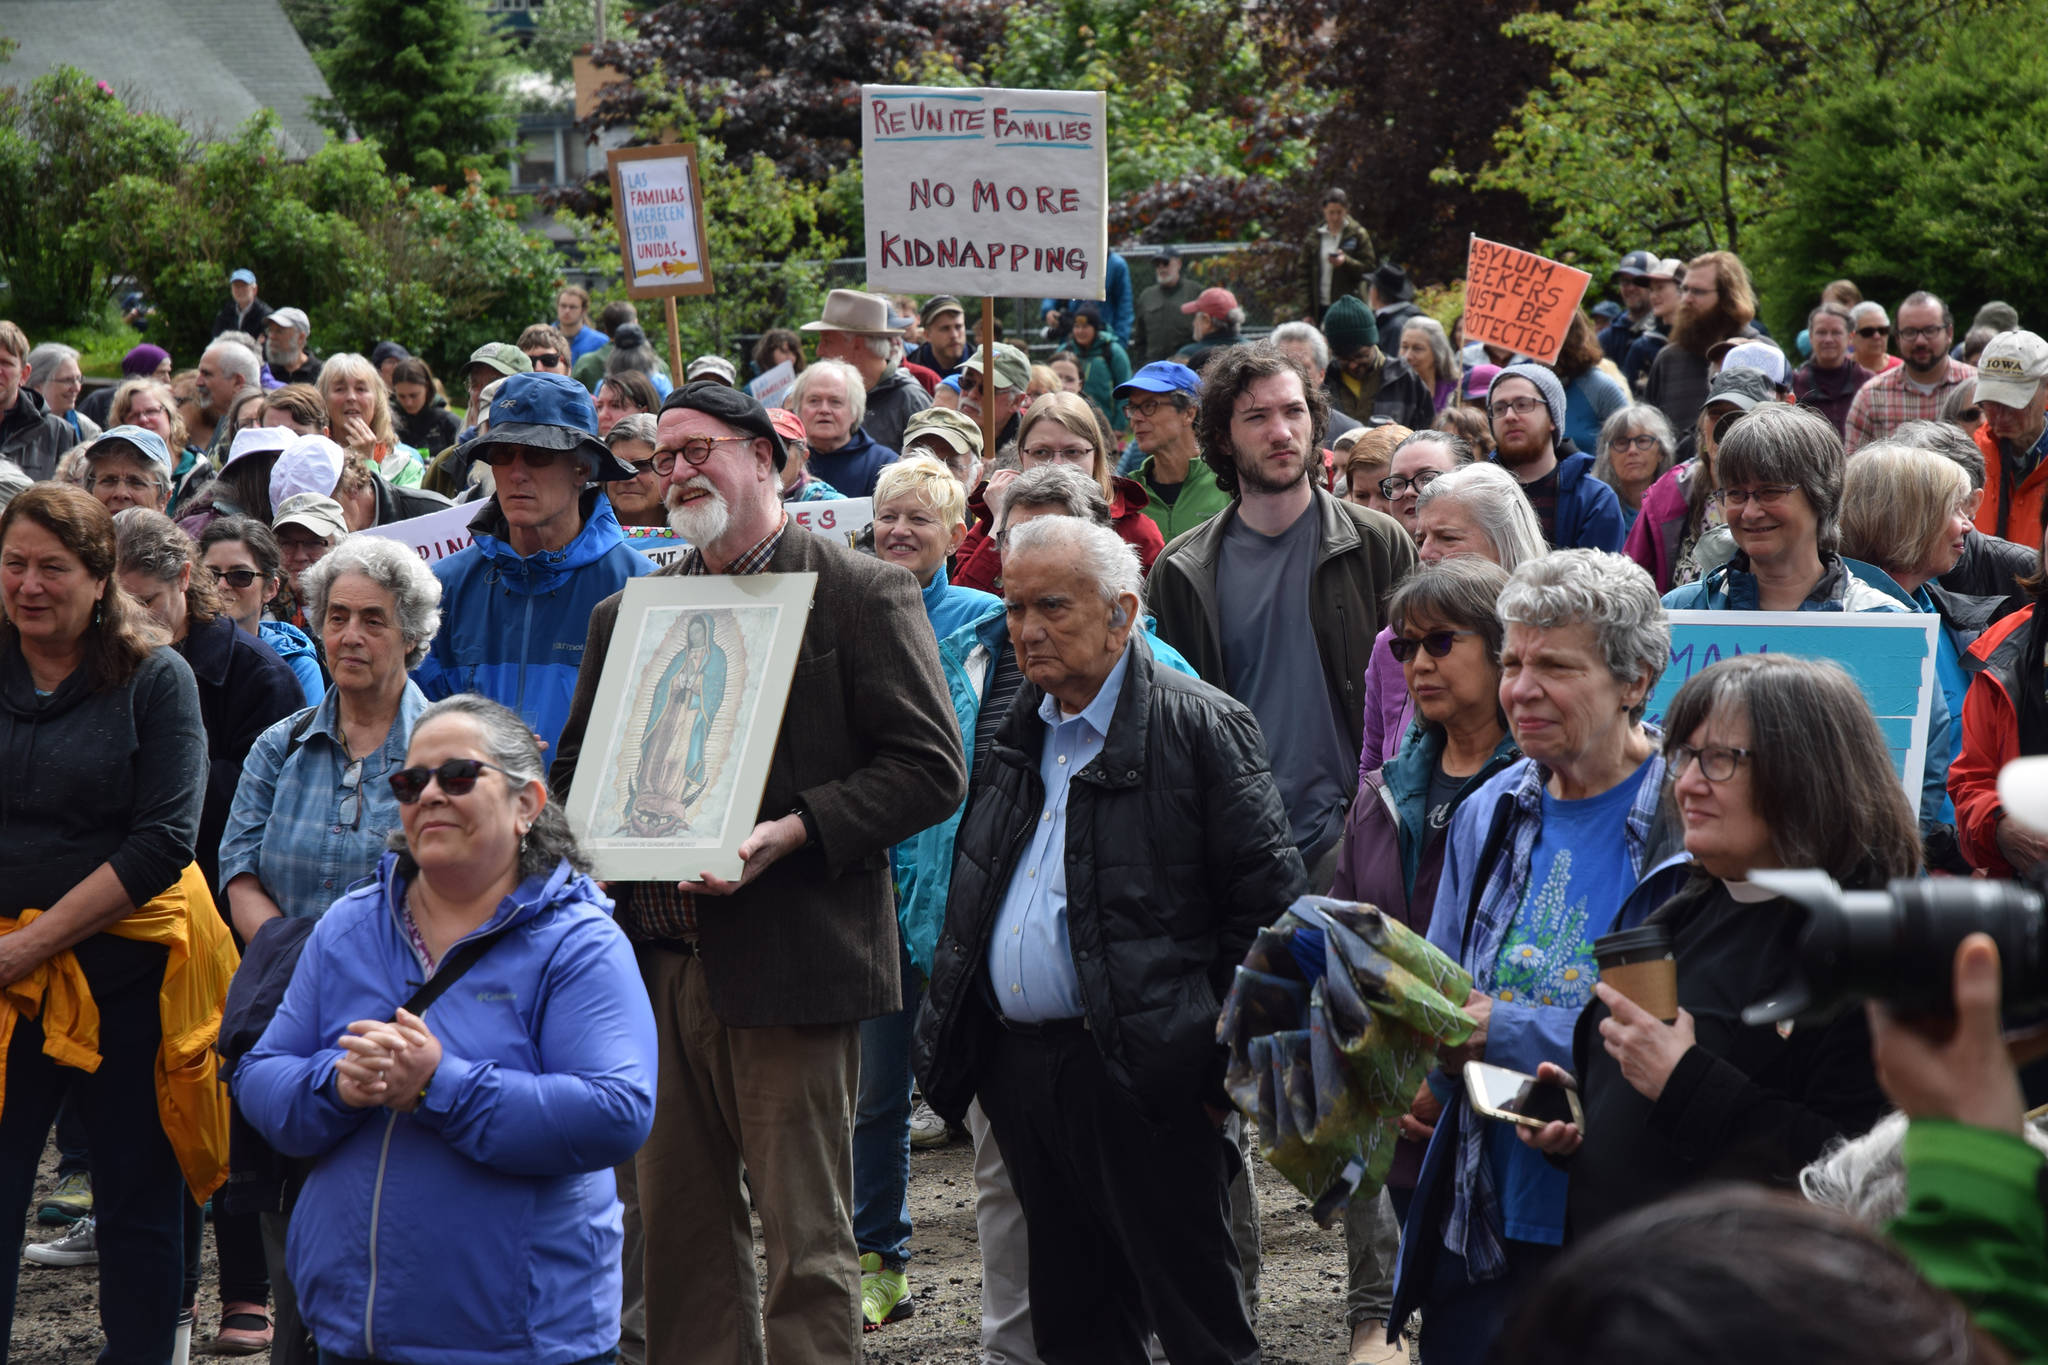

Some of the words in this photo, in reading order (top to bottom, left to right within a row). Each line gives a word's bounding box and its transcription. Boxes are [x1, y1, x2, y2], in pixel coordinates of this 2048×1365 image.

[993, 108, 1092, 141] FAMILIES
[627, 172, 648, 189] LAS
[630, 187, 685, 206] FAMILIAS
[910, 178, 955, 211] NO
[973, 178, 1080, 215] MORE
[632, 204, 685, 224] MERECEN
[635, 224, 668, 242] ESTAR
[637, 241, 678, 259] UNIDAS
[881, 230, 1088, 279] KIDNAPPING
[1471, 241, 1555, 283] ASYLUM
[1467, 286, 1506, 312] UST
[1516, 301, 1551, 329] BE
[1986, 359, 2023, 371] IOWA
